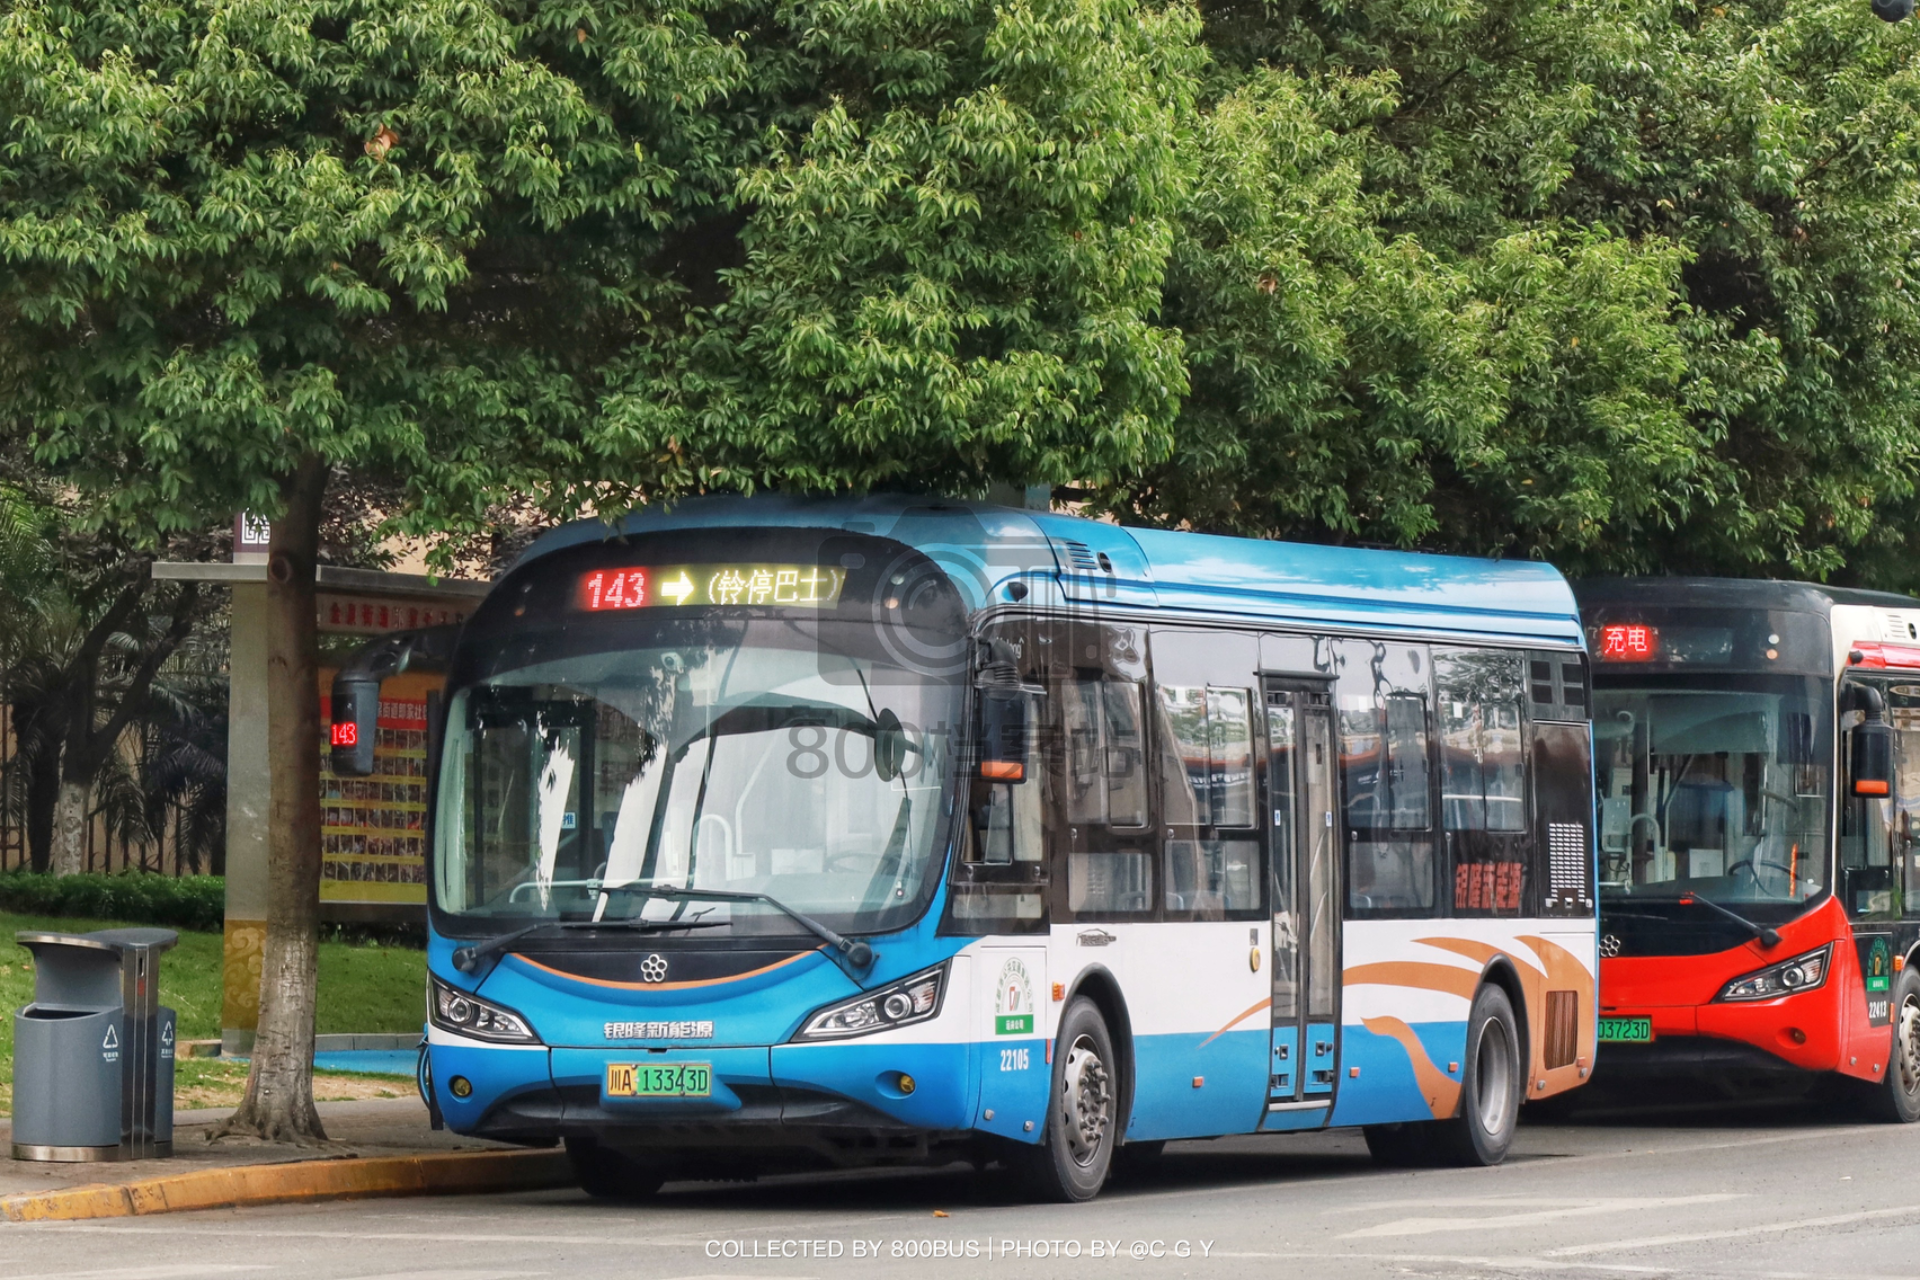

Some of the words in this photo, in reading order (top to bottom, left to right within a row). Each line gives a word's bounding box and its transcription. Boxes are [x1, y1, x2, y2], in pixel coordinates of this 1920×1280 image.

[587, 572, 645, 608] 143
[1604, 626, 1647, 654] 充电
[331, 723, 356, 745] 143
[1868, 1000, 1887, 1019] 22413
[603, 1020, 713, 1039] 银隆新能源
[1000, 1048, 1030, 1071] 22105
